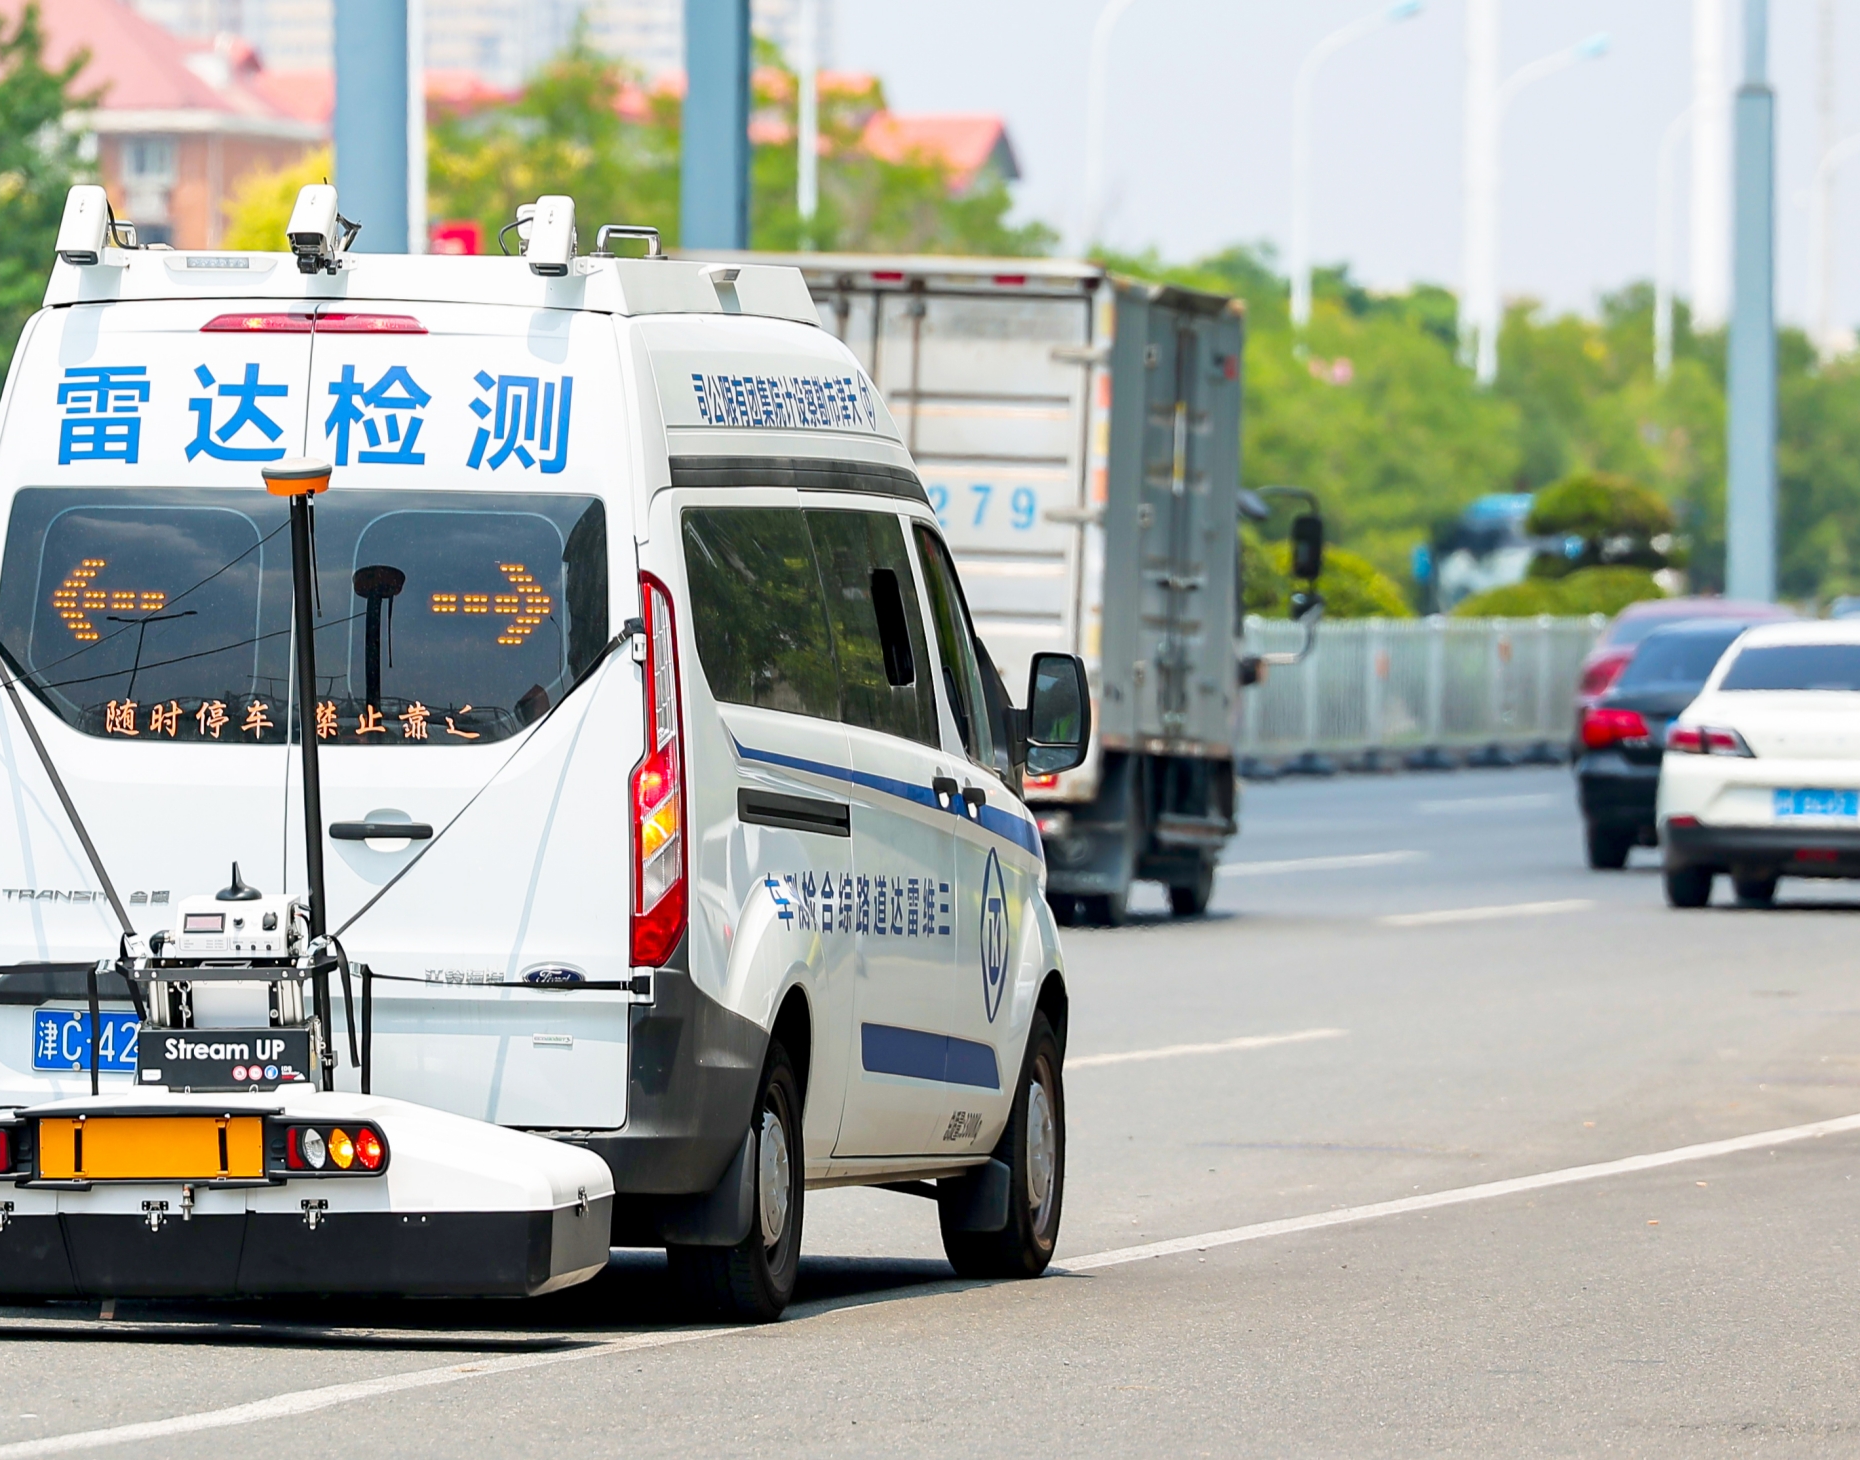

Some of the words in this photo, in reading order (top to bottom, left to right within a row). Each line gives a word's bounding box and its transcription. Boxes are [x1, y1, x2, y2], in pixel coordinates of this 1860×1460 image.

[56, 362, 574, 474] 雷达检测
[105, 700, 274, 739] 随时停车
[164, 1038, 249, 1060] Stream
[256, 1039, 285, 1060] UP
